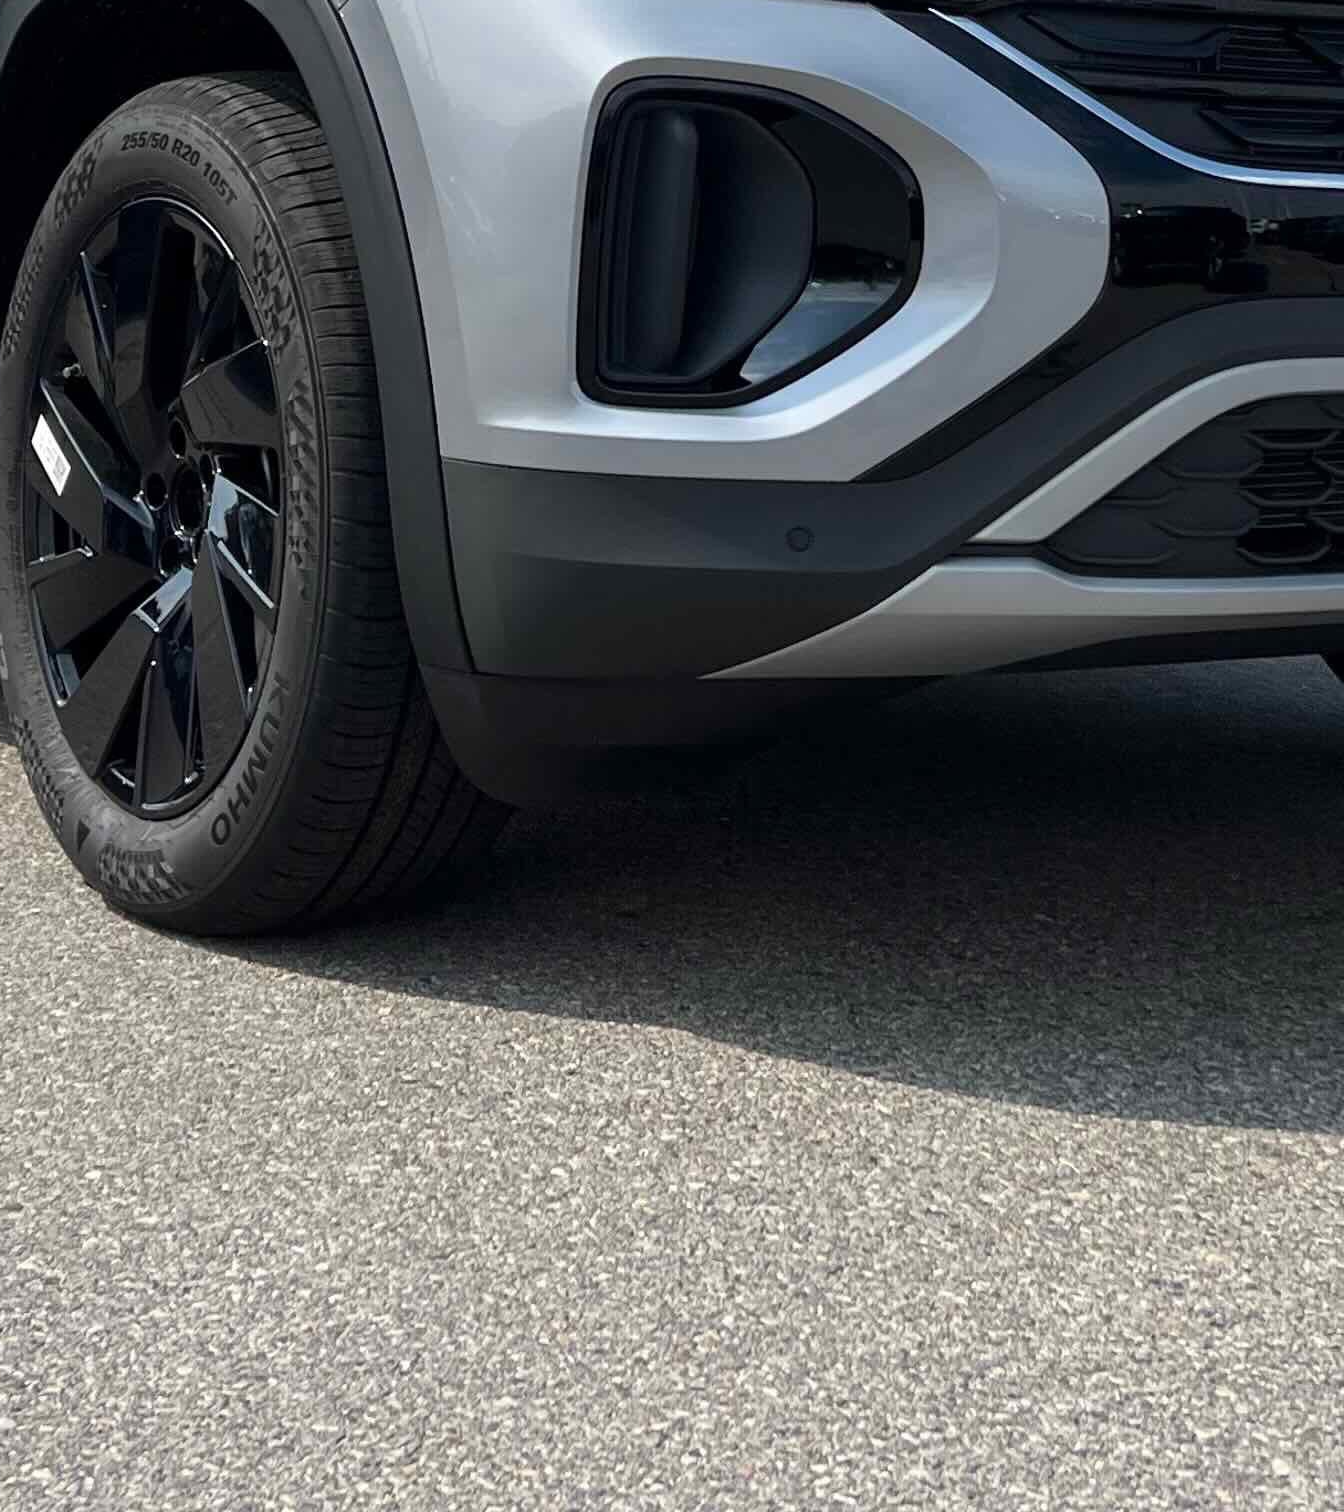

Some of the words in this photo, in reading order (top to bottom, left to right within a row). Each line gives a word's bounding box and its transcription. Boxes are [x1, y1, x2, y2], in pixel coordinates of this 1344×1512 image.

[121, 131, 169, 151] 255/50
[171, 138, 201, 167] R20
[203, 162, 238, 206] 105T
[211, 671, 290, 845] KUMHO
